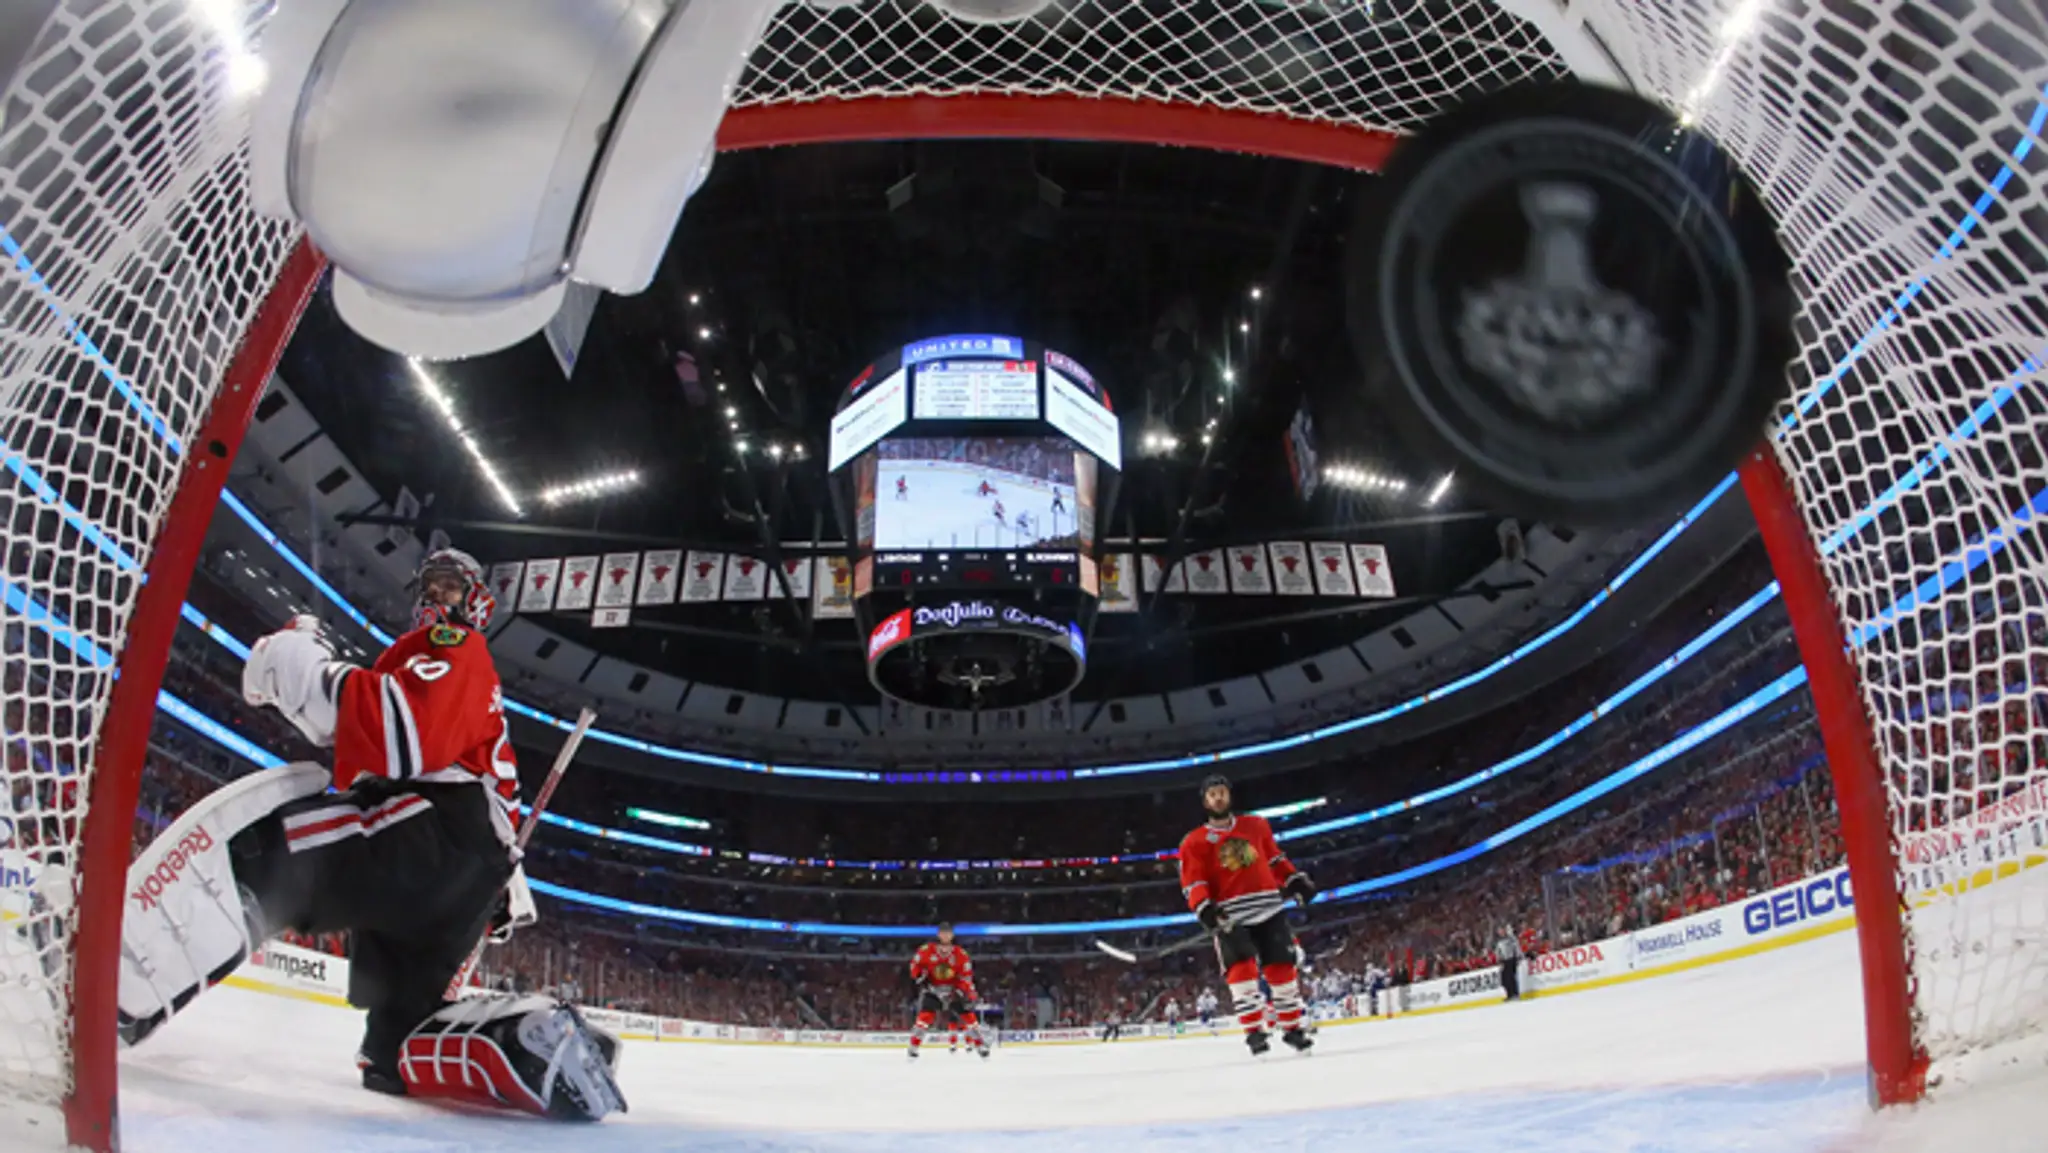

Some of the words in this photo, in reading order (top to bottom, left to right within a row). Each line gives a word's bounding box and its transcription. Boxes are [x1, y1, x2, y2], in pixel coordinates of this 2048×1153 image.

[911, 340, 988, 358] UNITED
[884, 771, 967, 784] UNITED
[986, 770, 1068, 783] CENTER
[131, 824, 214, 912] Reebok
[1527, 944, 1604, 975] HONDA
